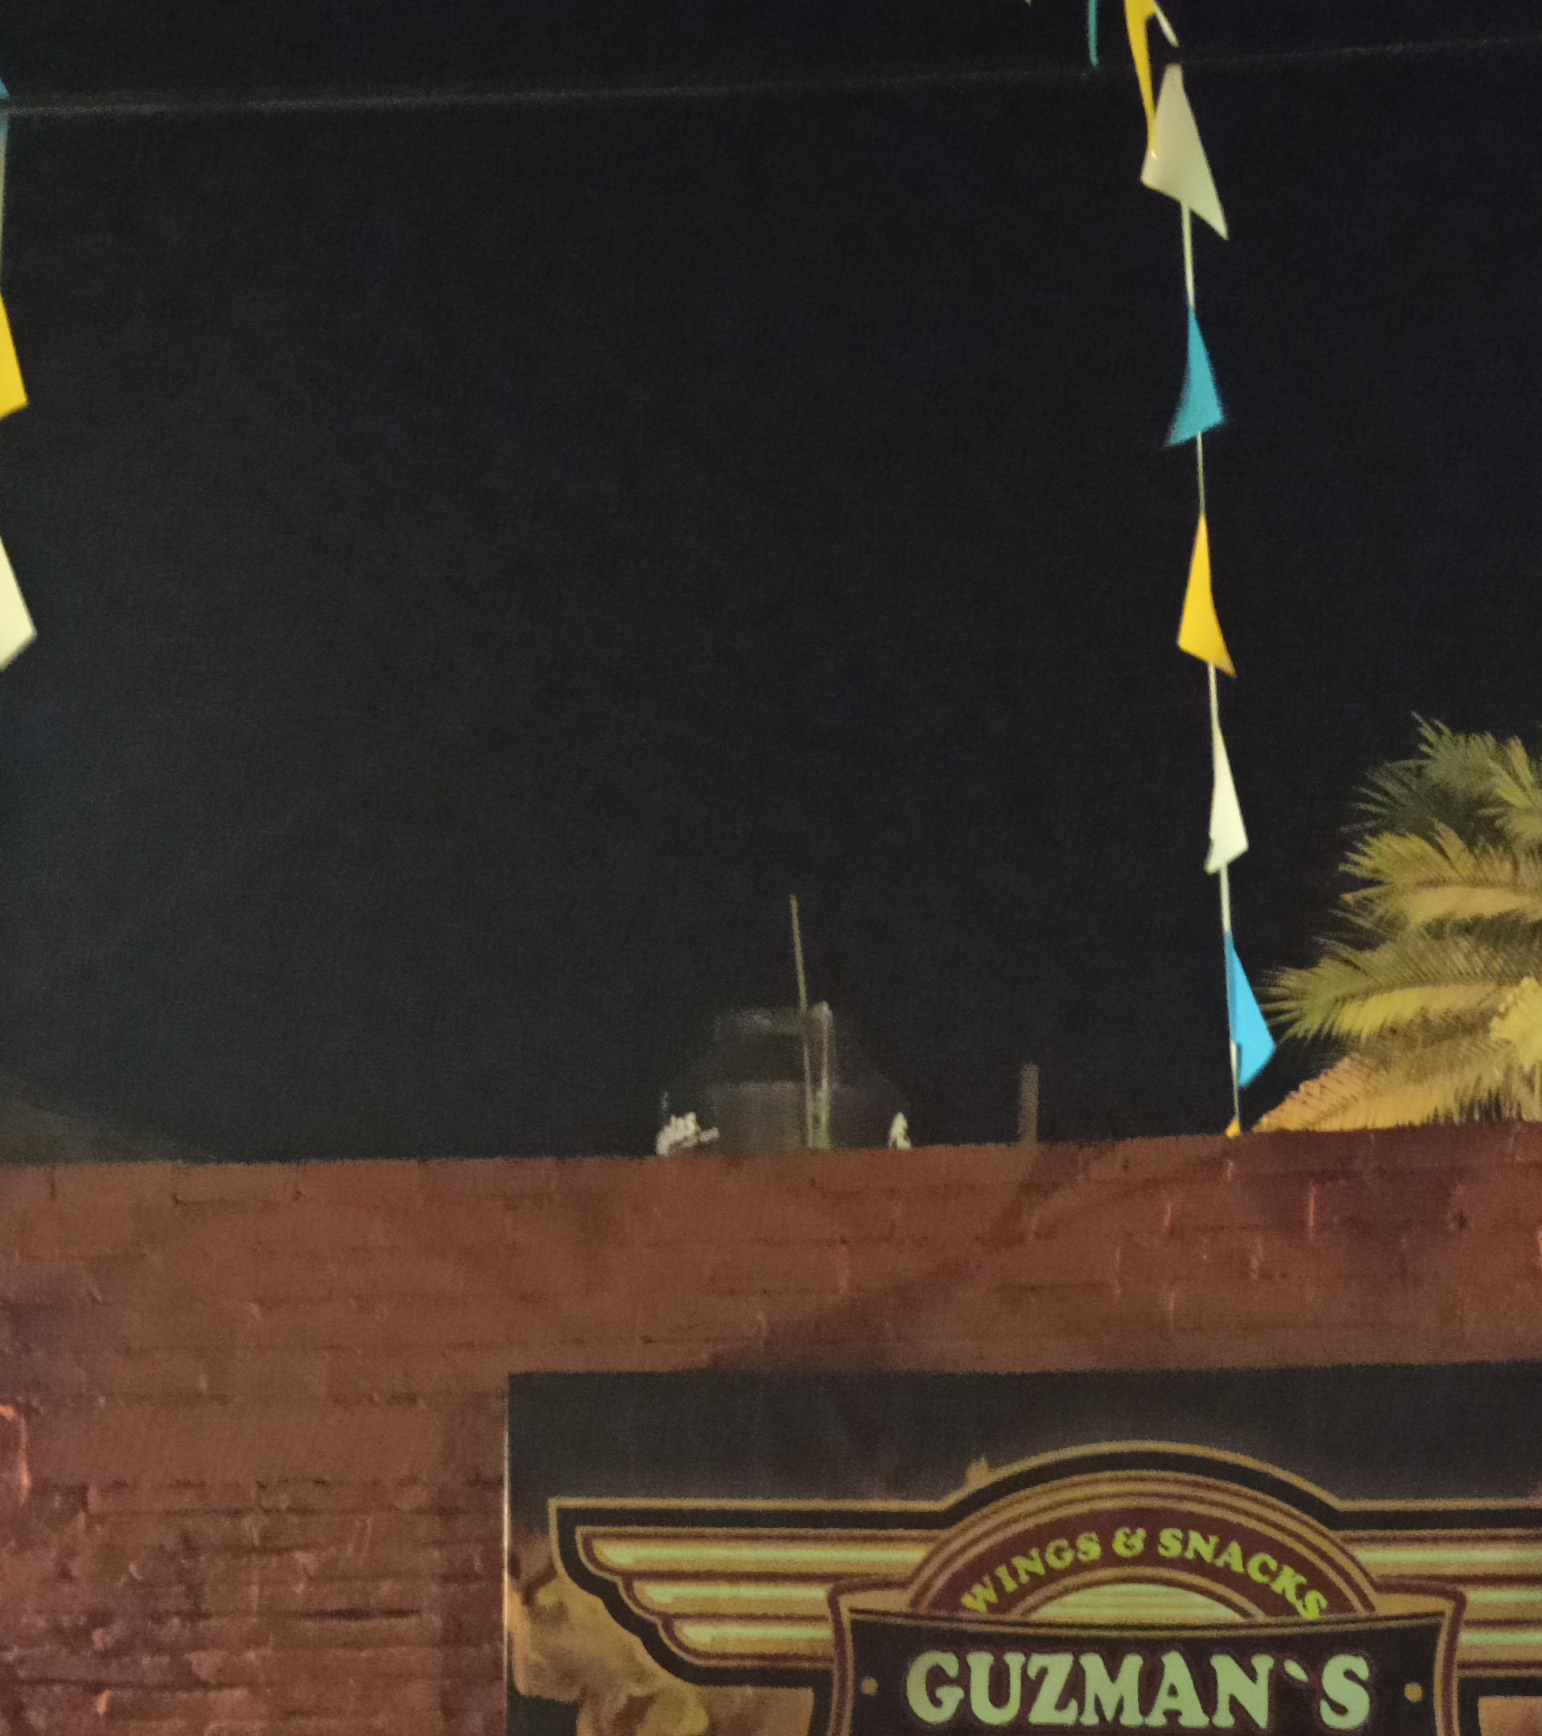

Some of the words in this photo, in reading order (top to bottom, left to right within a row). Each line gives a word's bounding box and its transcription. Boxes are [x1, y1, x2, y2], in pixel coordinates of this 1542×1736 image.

[961, 1532, 1102, 1613] WINGS
[1112, 1527, 1147, 1558] &
[1159, 1528, 1328, 1620] SNACKS
